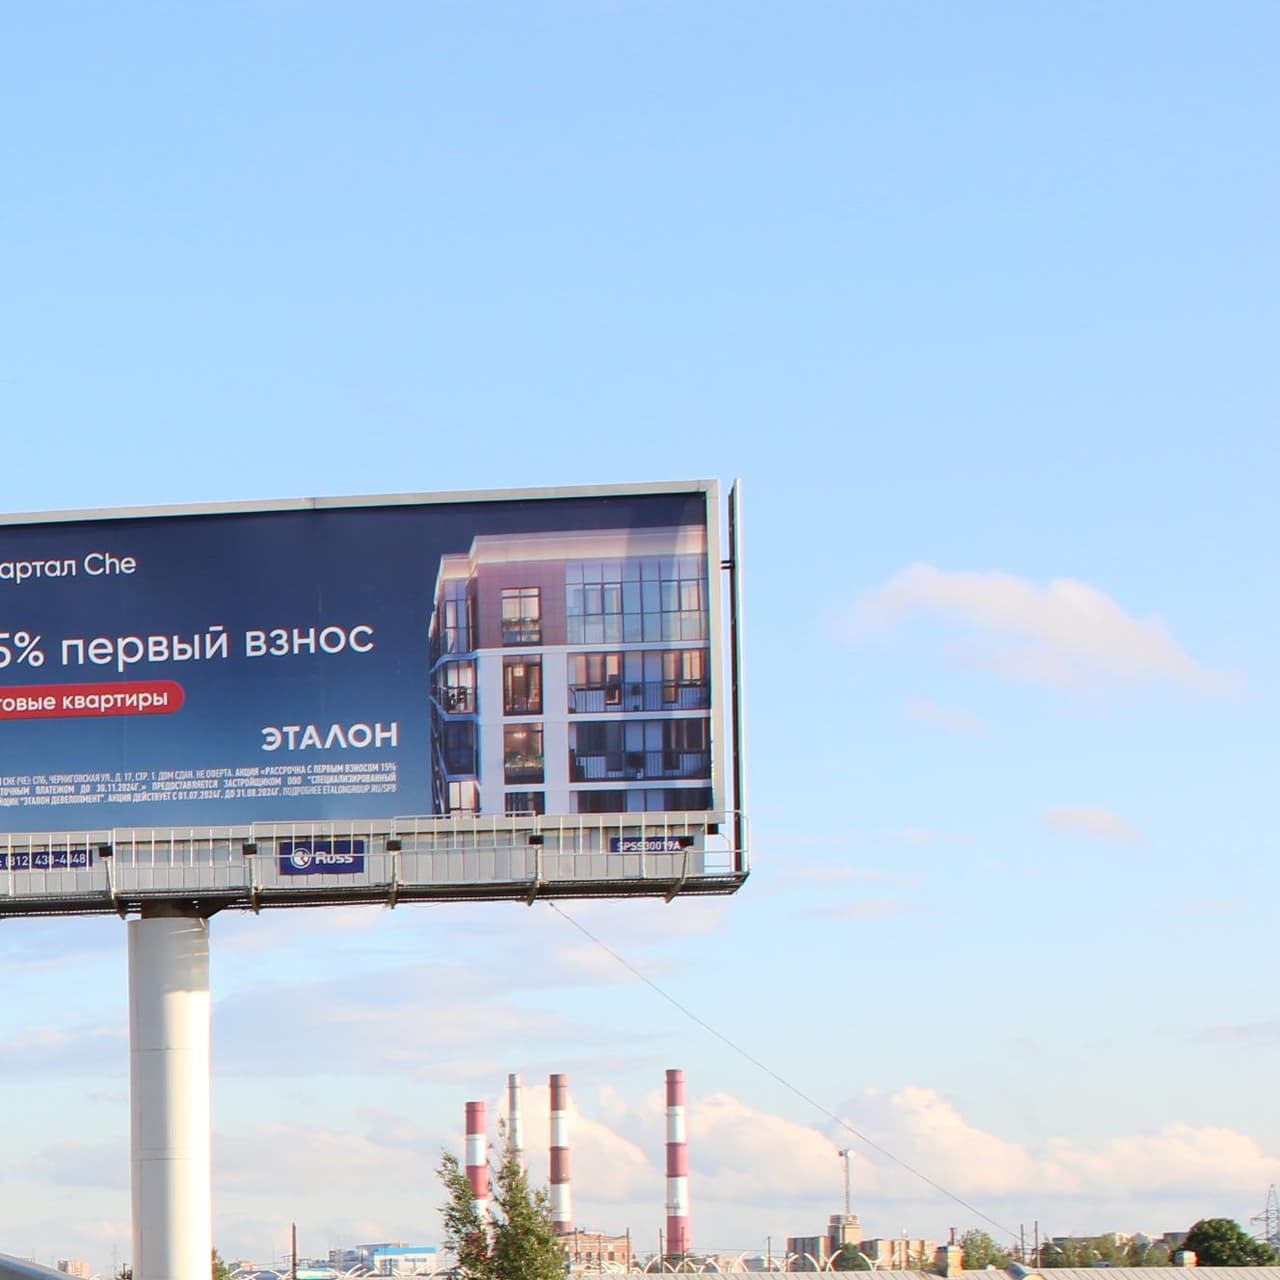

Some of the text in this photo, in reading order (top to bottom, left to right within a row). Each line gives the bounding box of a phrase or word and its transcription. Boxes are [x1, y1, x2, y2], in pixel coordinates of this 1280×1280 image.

[84, 552, 137, 576] Che
[61, 625, 229, 672] первый
[246, 625, 374, 657] взнос
[62, 692, 168, 712] квартиры
[261, 722, 397, 751] ЭТАЛОН
